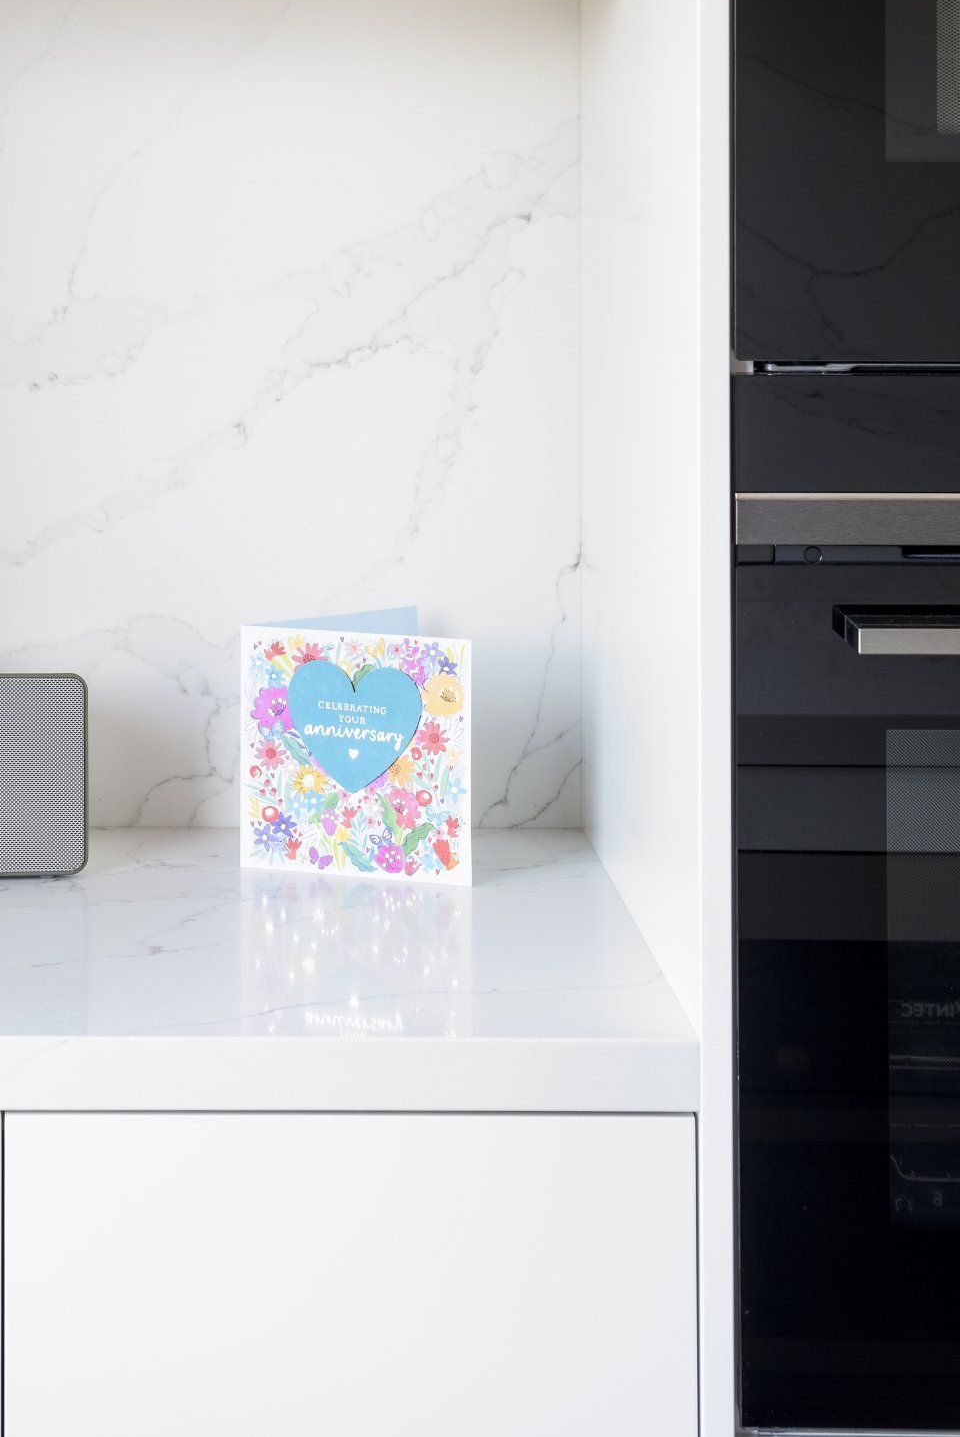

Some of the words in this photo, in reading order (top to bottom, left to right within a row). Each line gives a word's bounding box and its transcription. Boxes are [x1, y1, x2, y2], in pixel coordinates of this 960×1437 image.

[317, 700, 387, 716] CELEBRATING
[338, 713, 367, 726] YOUR
[303, 723, 404, 751] anniversary
